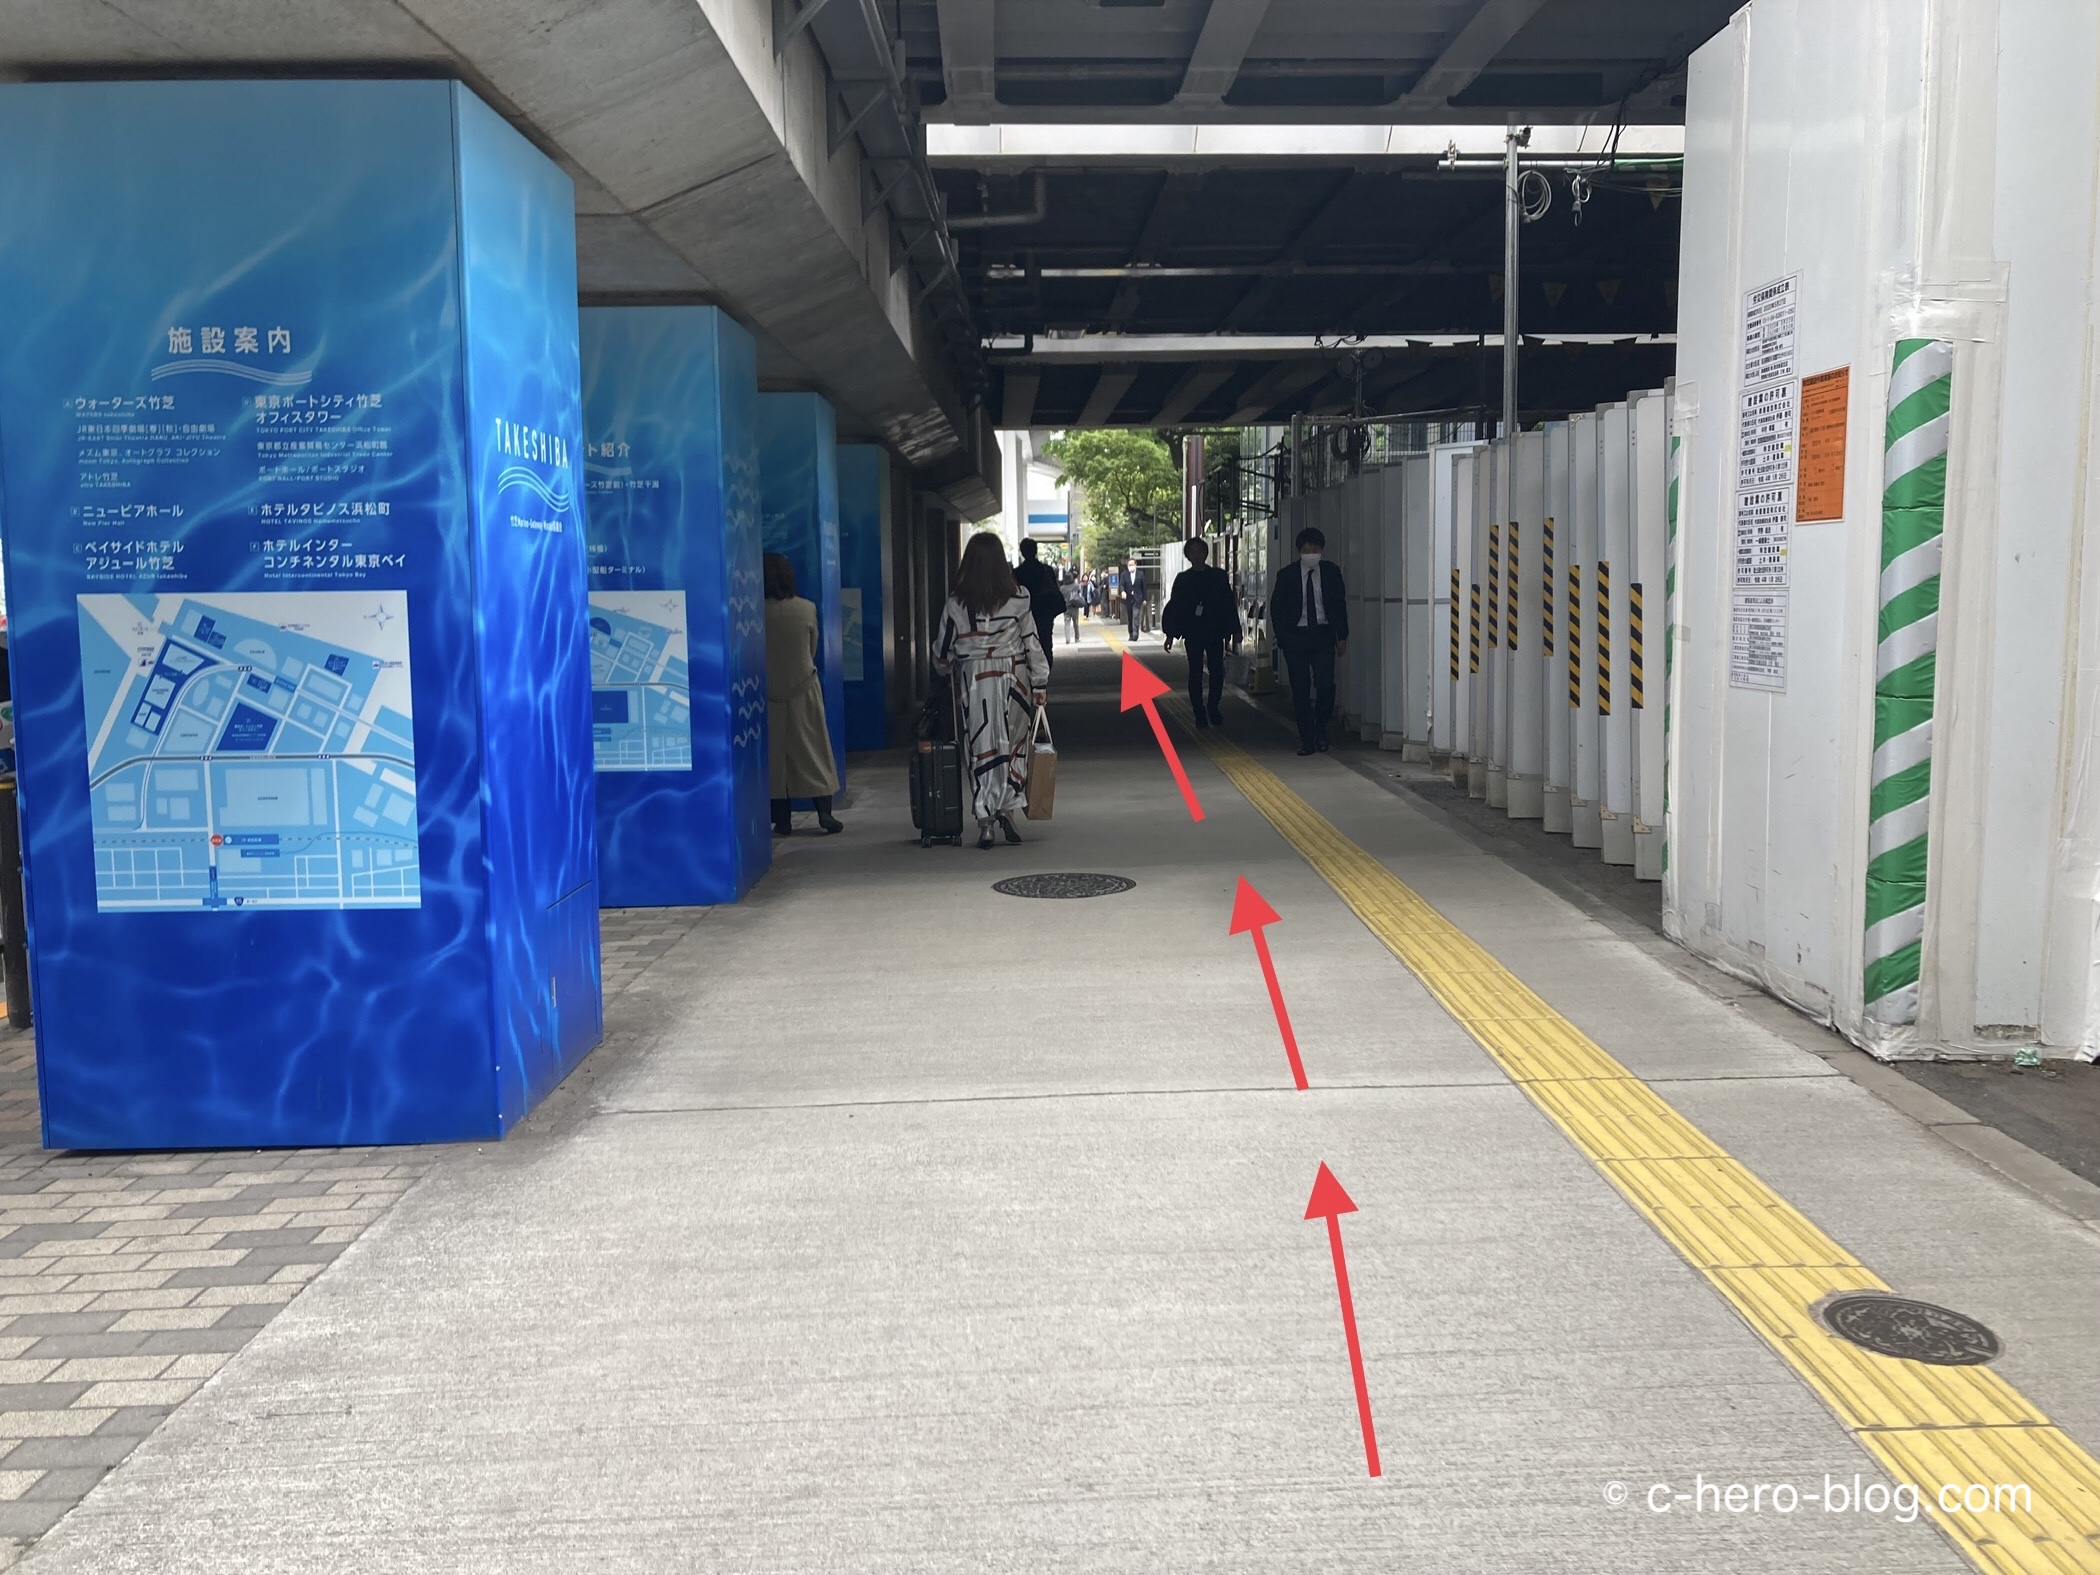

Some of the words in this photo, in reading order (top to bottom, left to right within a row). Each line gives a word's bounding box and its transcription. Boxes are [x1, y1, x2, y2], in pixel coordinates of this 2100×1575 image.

[168, 326, 291, 354] 施設案内
[75, 395, 175, 410] ウォーターズ竹芝
[255, 394, 382, 409] 東京ポートシティ竹芝
[256, 411, 342, 425] オフィスタワー
[495, 417, 569, 469] TAKESHIBA
[582, 442, 631, 458] ト紹介
[80, 472, 119, 482] アトレ竹芝
[83, 504, 184, 518] ニューピアホール
[261, 502, 390, 516] ホテルタビノス浜松町
[85, 540, 184, 554] ベイサイドホテル
[263, 539, 352, 552] ホテルインター
[86, 556, 175, 570] アジュール竹芝
[264, 554, 406, 569] コンチネンタル東京ベイ
